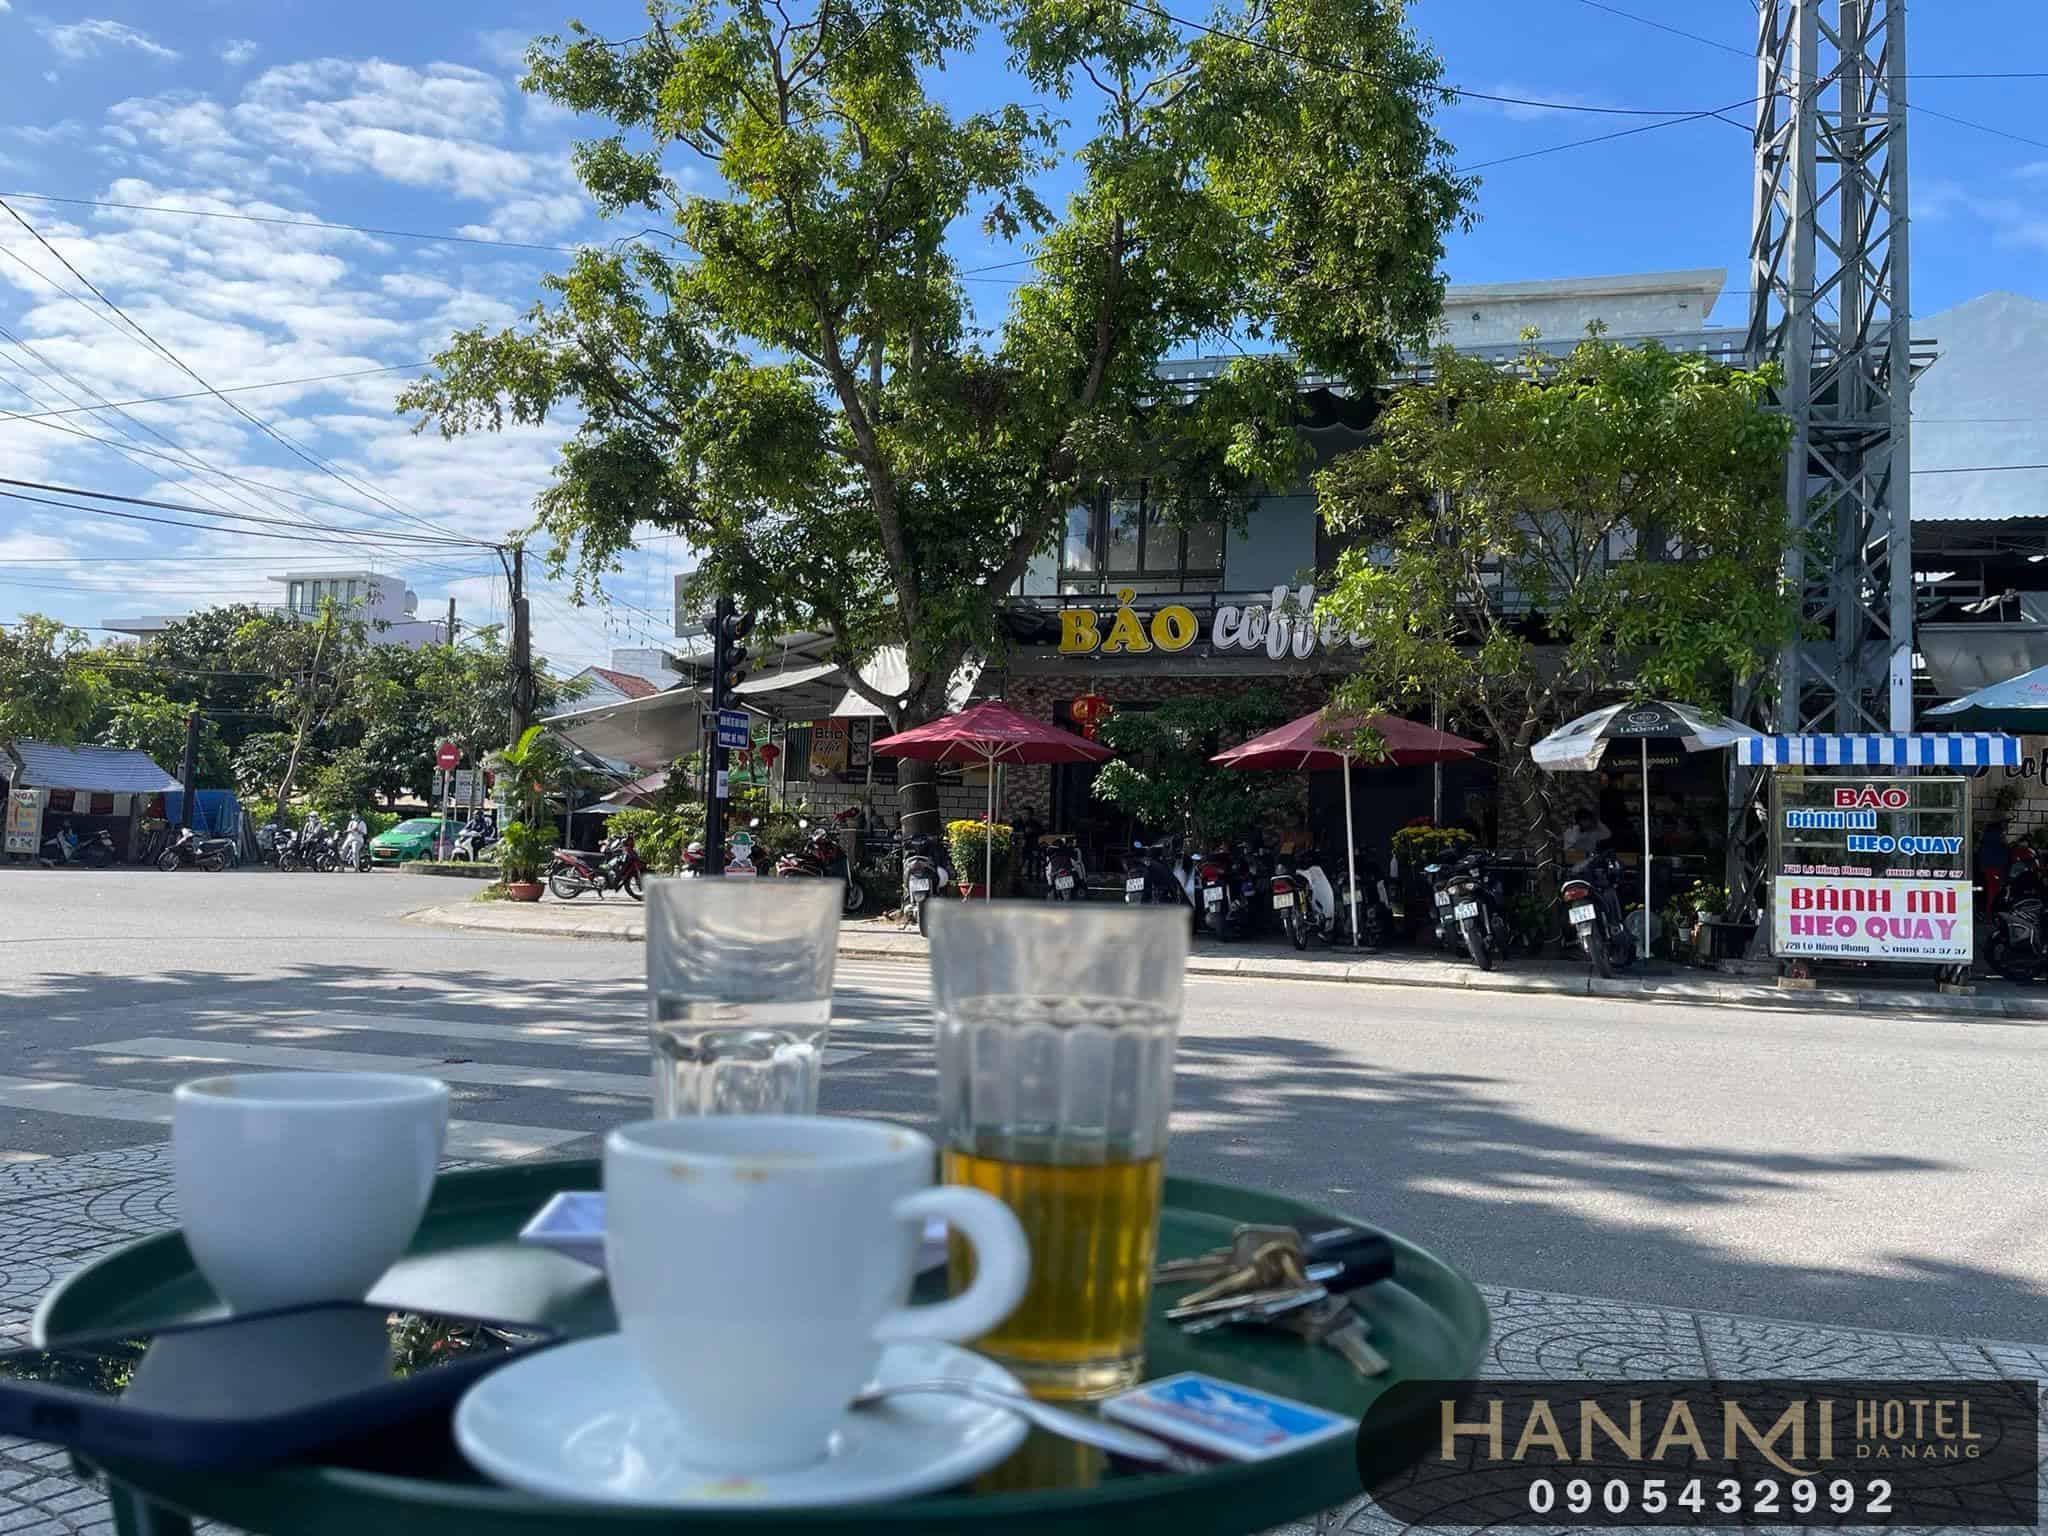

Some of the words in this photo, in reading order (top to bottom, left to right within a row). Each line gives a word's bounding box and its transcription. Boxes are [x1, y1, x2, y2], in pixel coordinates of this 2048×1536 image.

[1057, 587, 1199, 655] BẢO
[1834, 784, 1909, 809] BẢO
[1786, 809, 1846, 829] BÁNH
[1847, 834, 1897, 853] HEO
[1898, 835, 1964, 855] QUAY
[1790, 884, 1891, 913] BÁNH
[1907, 886, 1957, 914] MÌ
[1790, 914, 1857, 938] HEO
[1864, 916, 1958, 941] QUAY
